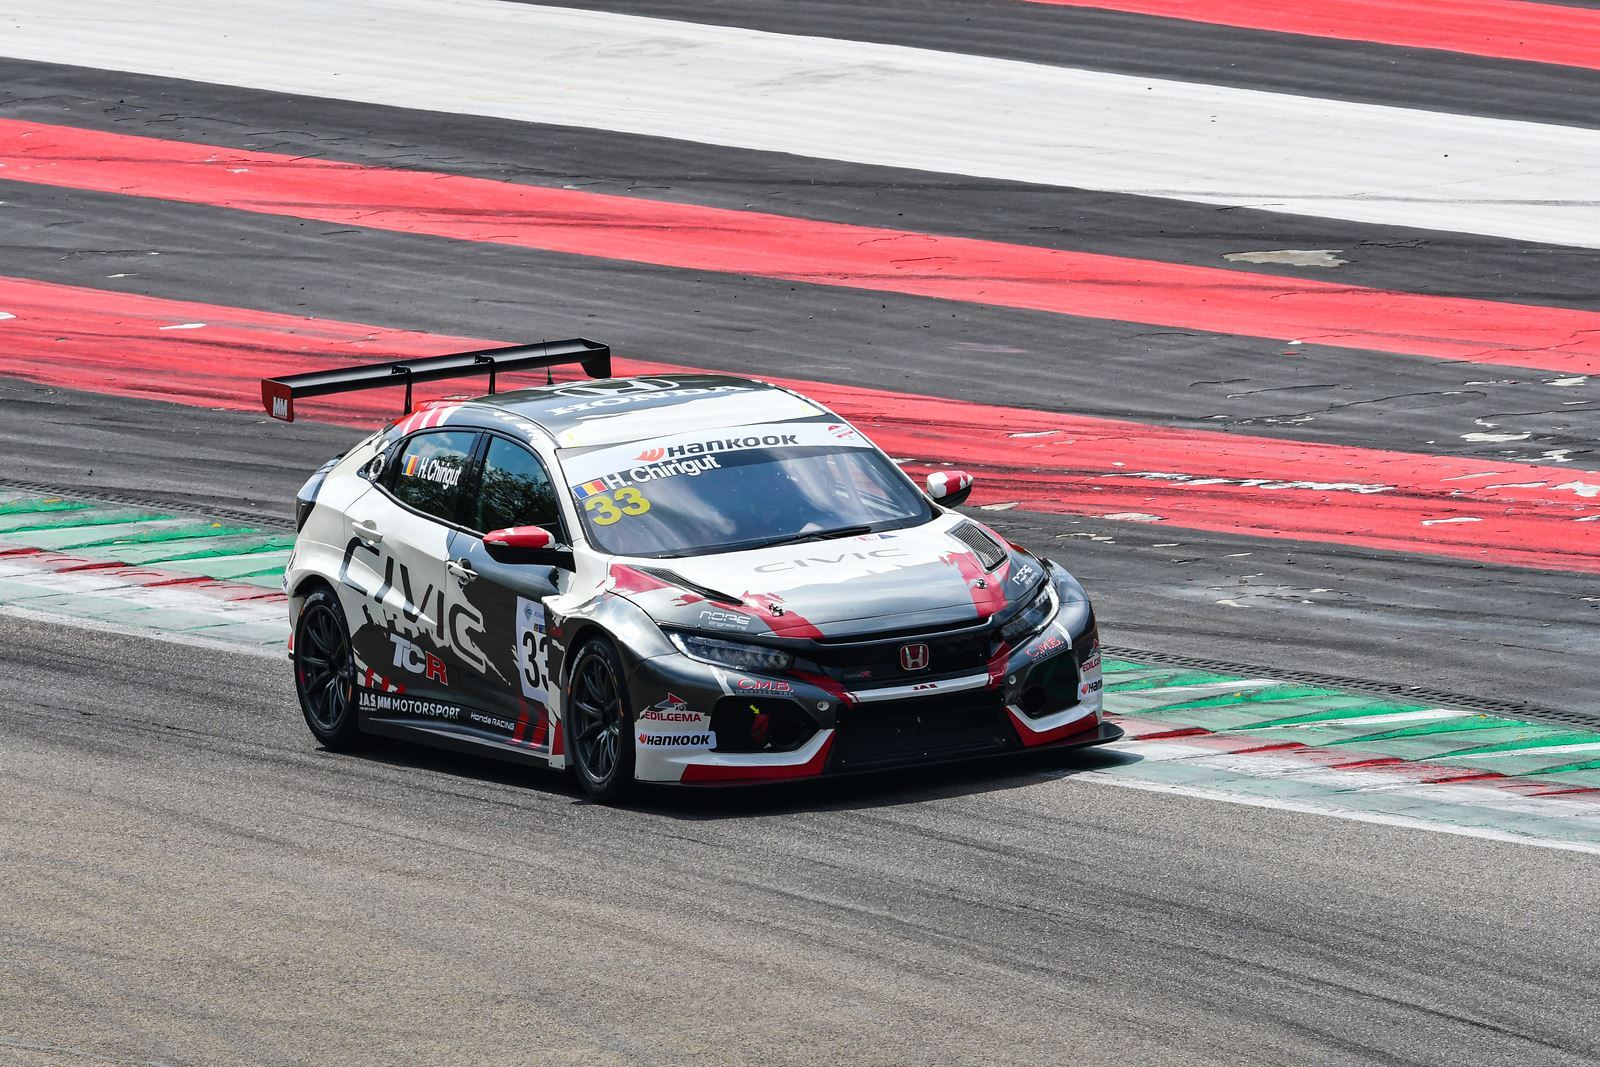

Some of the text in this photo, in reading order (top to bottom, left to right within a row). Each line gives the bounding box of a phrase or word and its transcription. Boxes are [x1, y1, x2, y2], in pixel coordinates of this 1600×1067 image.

[545, 385, 754, 415] HONDA
[584, 487, 651, 526] 33
[754, 548, 909, 573] CIVIC
[338, 537, 484, 666] CIVIC
[389, 632, 449, 686] TCR
[392, 697, 461, 720] MOTORSPORT
[470, 711, 515, 731] Honda RACING
[645, 711, 702, 722] EDILGEMA
